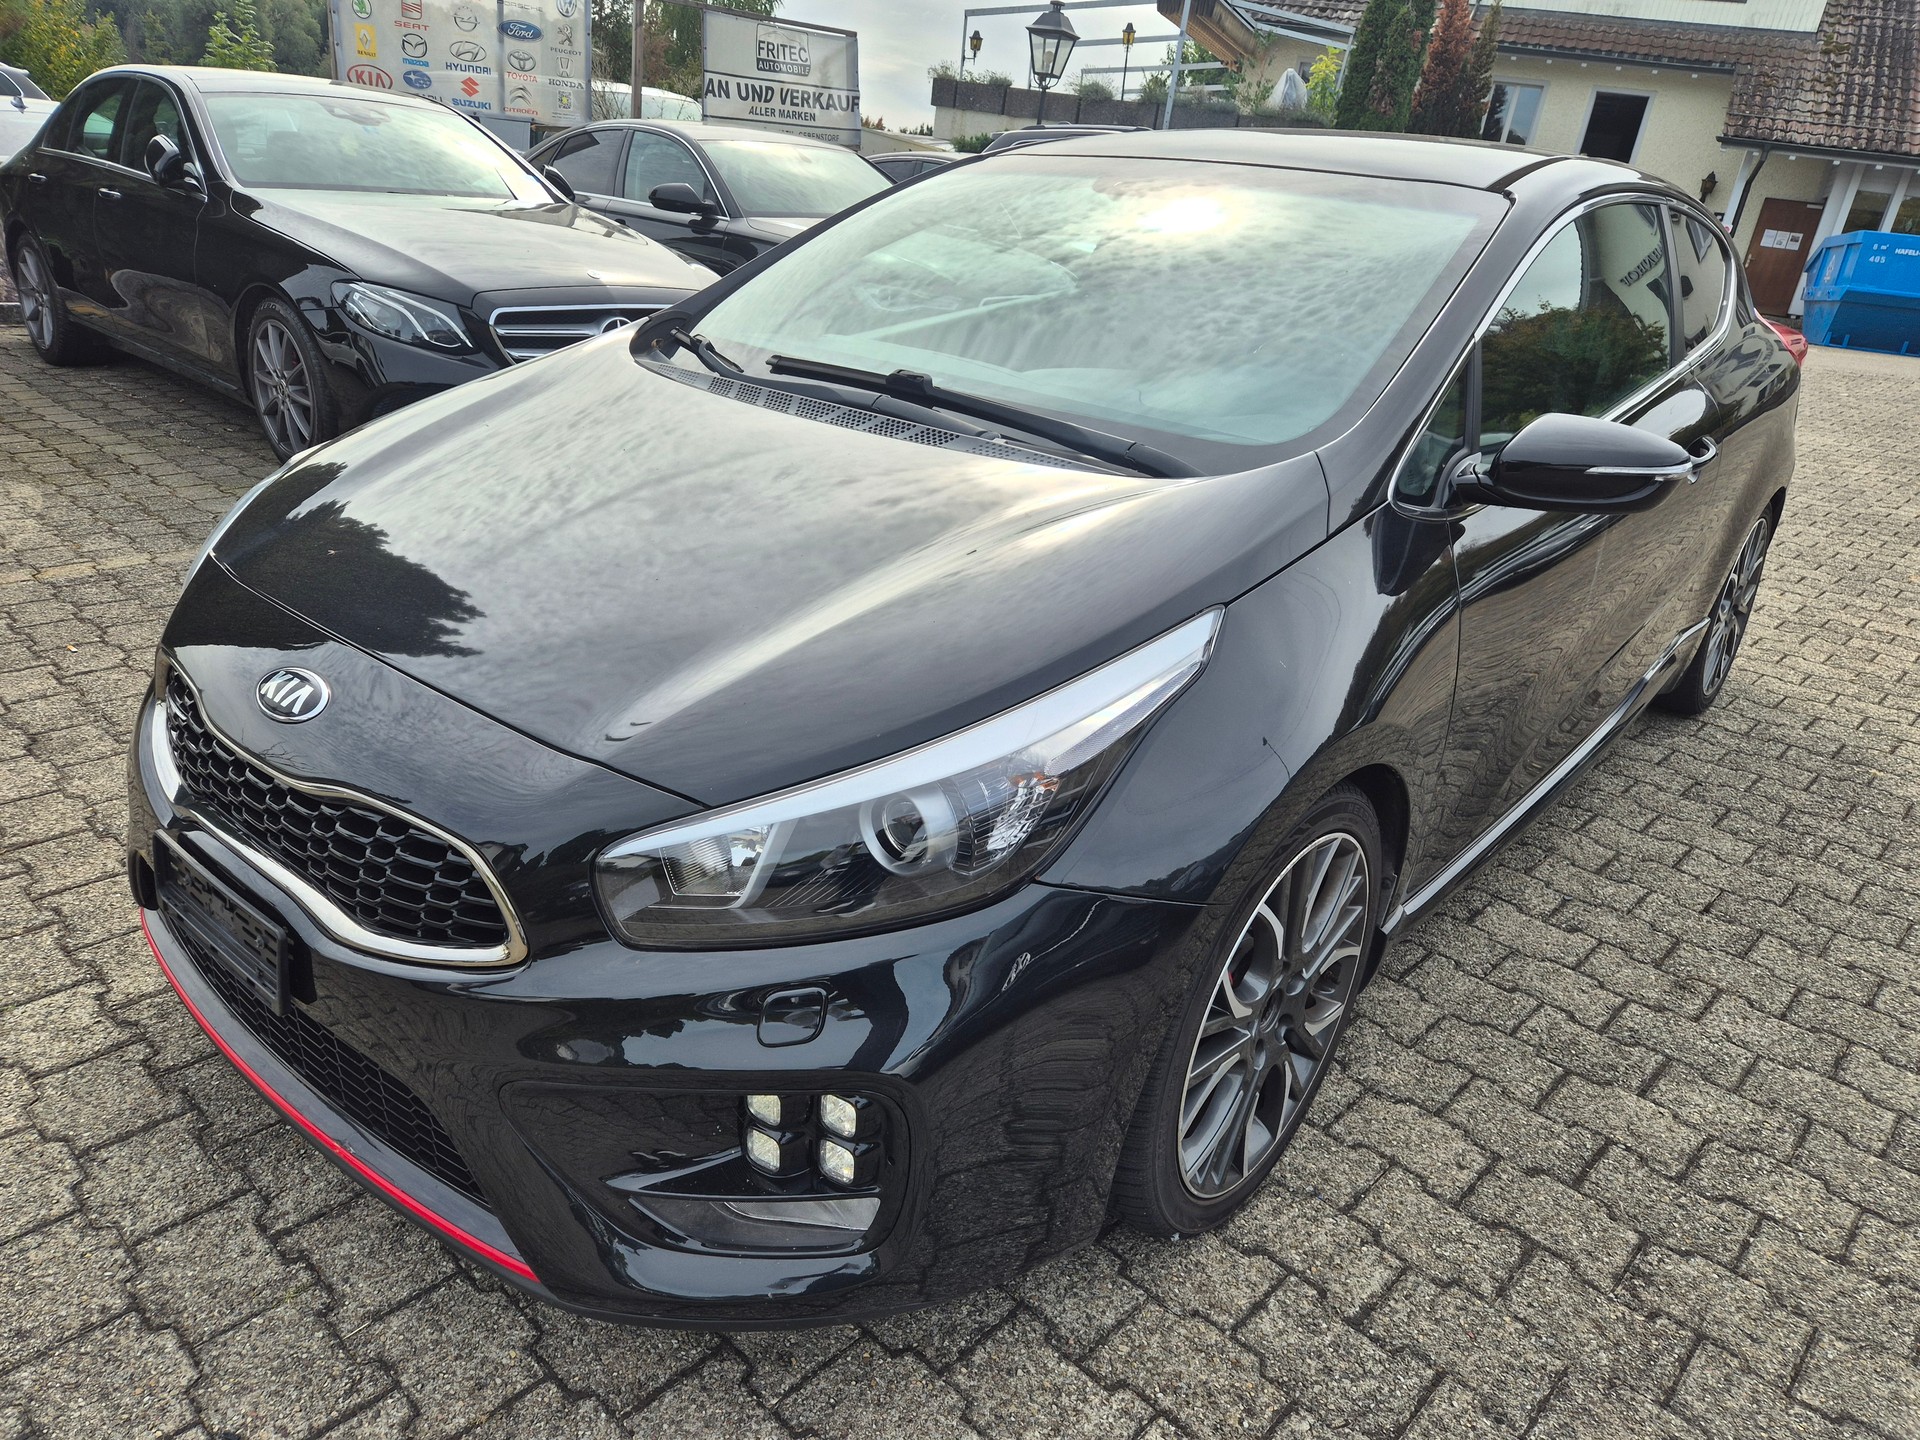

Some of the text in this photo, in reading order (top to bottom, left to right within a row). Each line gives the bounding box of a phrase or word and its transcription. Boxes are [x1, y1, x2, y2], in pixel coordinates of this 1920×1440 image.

[394, 20, 430, 31] SEAT
[507, 22, 535, 39] Ford
[550, 46, 582, 56] PEUGEOT
[758, 40, 809, 63] FRITEC
[445, 62, 492, 75] HYUNDAI
[758, 61, 810, 75] AUTOMOBILE
[354, 69, 387, 88] KIA
[507, 71, 538, 83] TOYOTA
[548, 78, 585, 90] HONDA
[704, 78, 860, 114] AN UND VERKAUF
[451, 98, 492, 110] SUZUKI
[749, 106, 816, 122] ALLER MARKEN
[1868, 254, 1886, 264] 405
[260, 670, 314, 715] KIA
